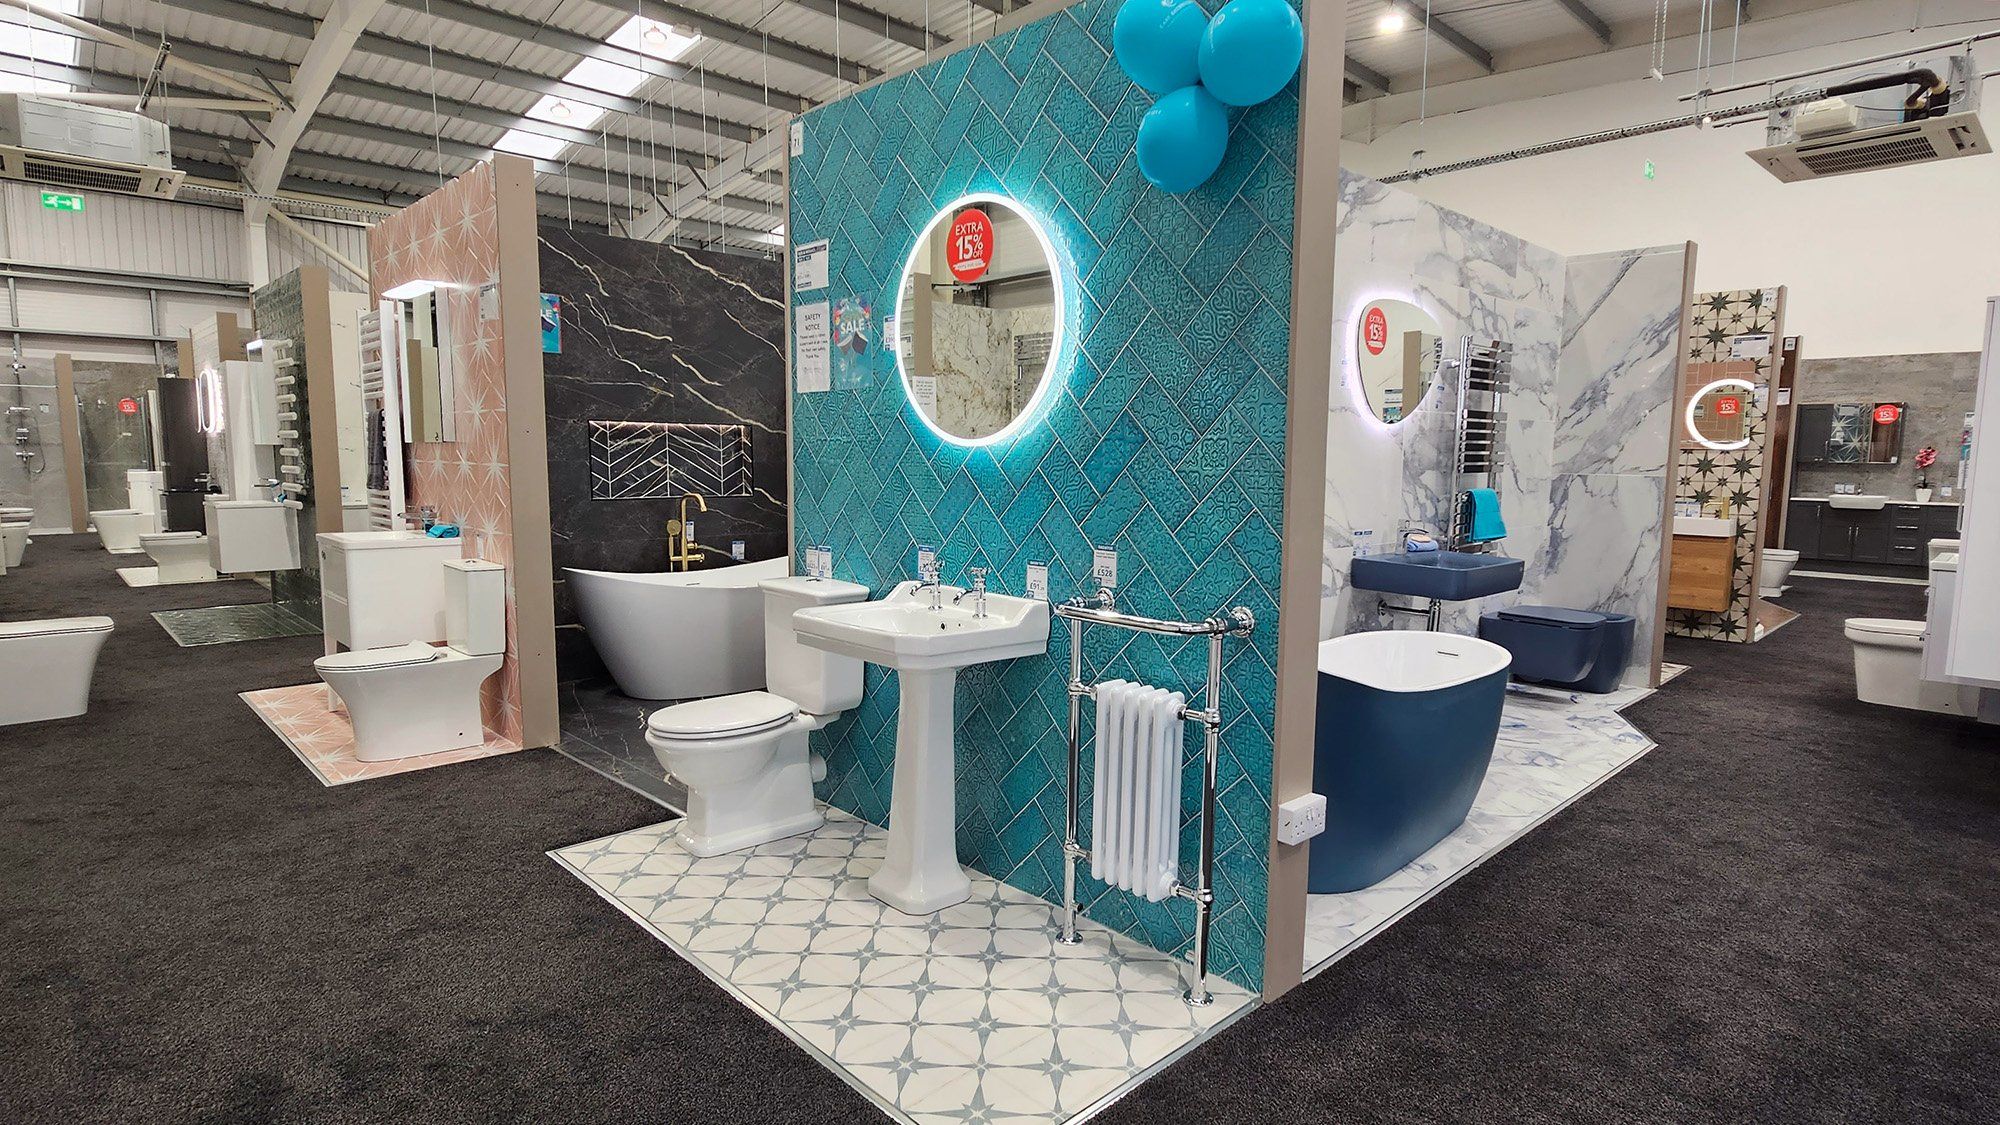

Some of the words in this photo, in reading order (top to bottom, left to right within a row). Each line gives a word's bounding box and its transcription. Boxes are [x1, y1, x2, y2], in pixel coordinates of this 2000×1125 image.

[955, 221, 983, 236] EXTRA
[956, 233, 984, 260] 15%
[973, 250, 983, 258] OFF
[804, 313, 821, 321] SAFETY
[804, 323, 820, 331] NOTICE
[840, 319, 865, 334] SALE
[1097, 569, 1113, 578] £528
